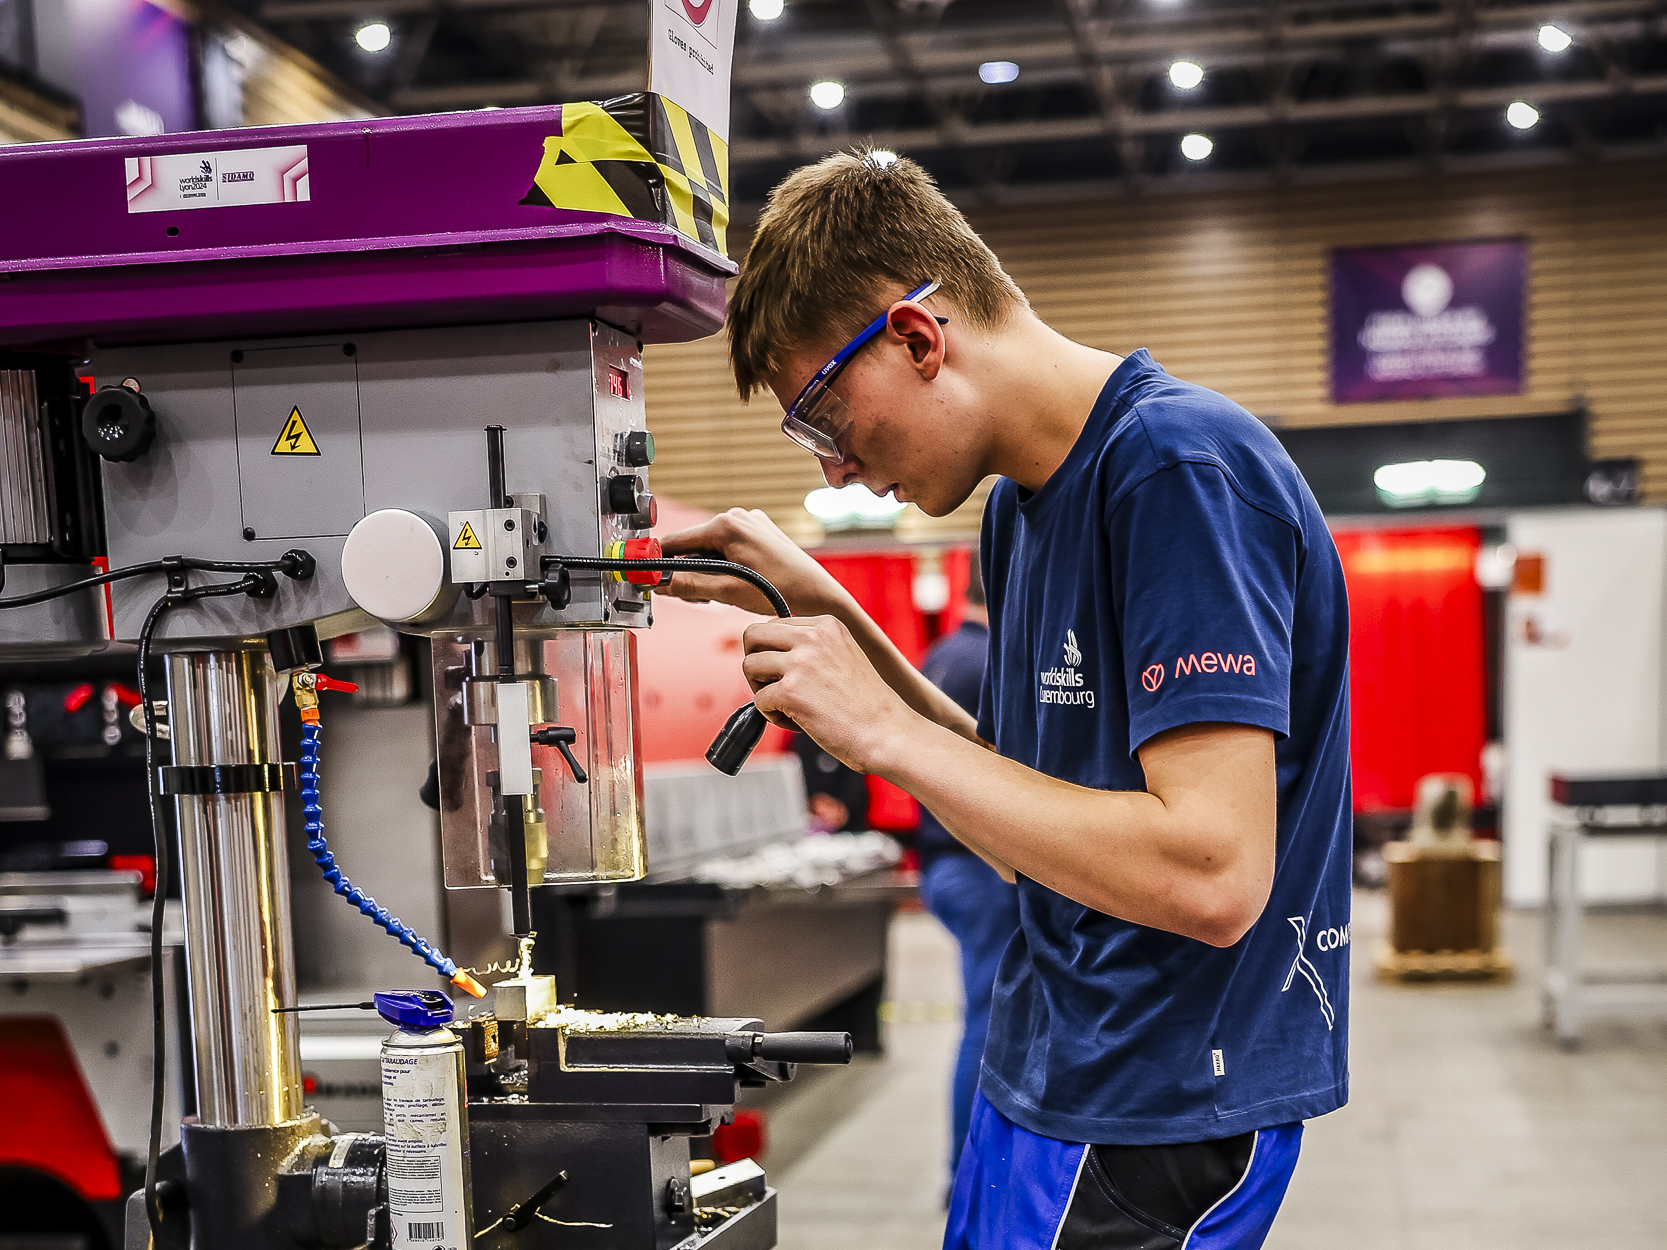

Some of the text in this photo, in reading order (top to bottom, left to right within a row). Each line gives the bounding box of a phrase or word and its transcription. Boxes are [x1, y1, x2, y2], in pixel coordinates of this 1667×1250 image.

[668, 28, 687, 52] Gloves
[179, 175, 213, 184] worldskills
[222, 171, 254, 182] SIDAMO
